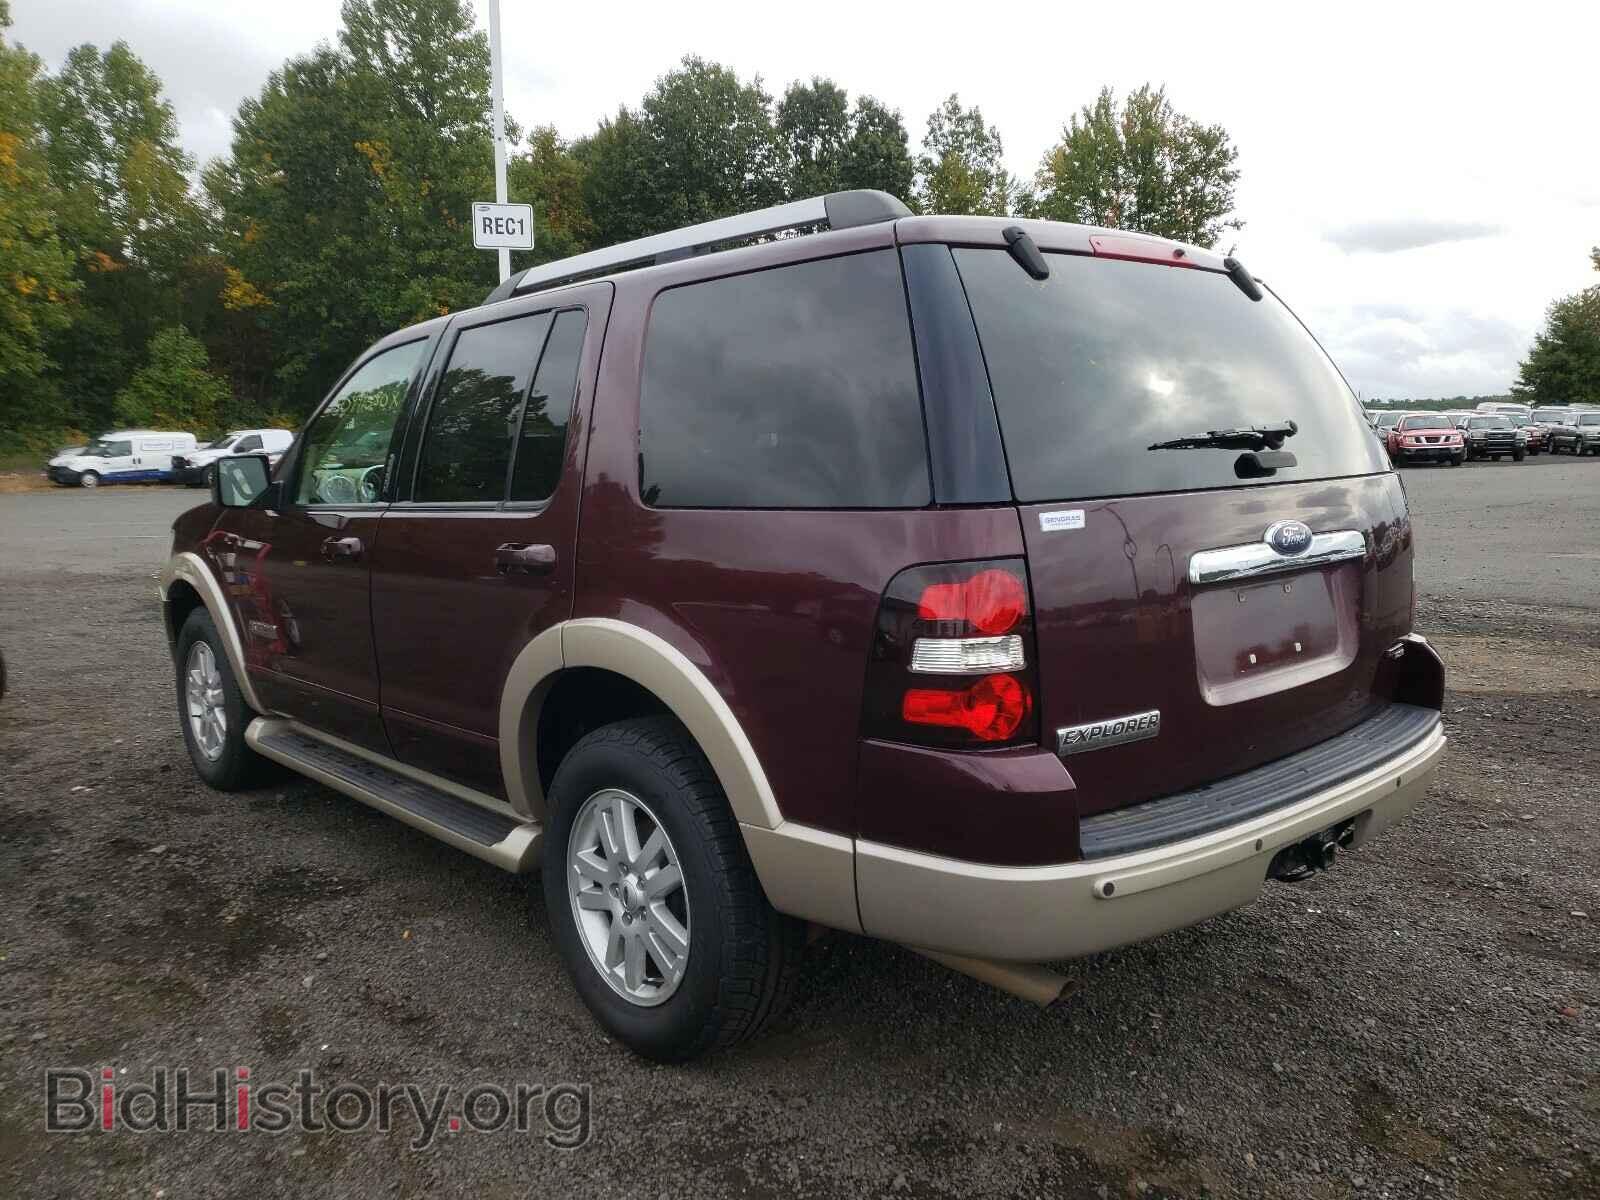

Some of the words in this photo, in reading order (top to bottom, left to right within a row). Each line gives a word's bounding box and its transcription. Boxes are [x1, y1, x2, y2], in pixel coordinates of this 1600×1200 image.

[482, 216, 524, 236] REC1
[1282, 527, 1306, 546] Ford
[1062, 714, 1159, 745] EXPLORER
